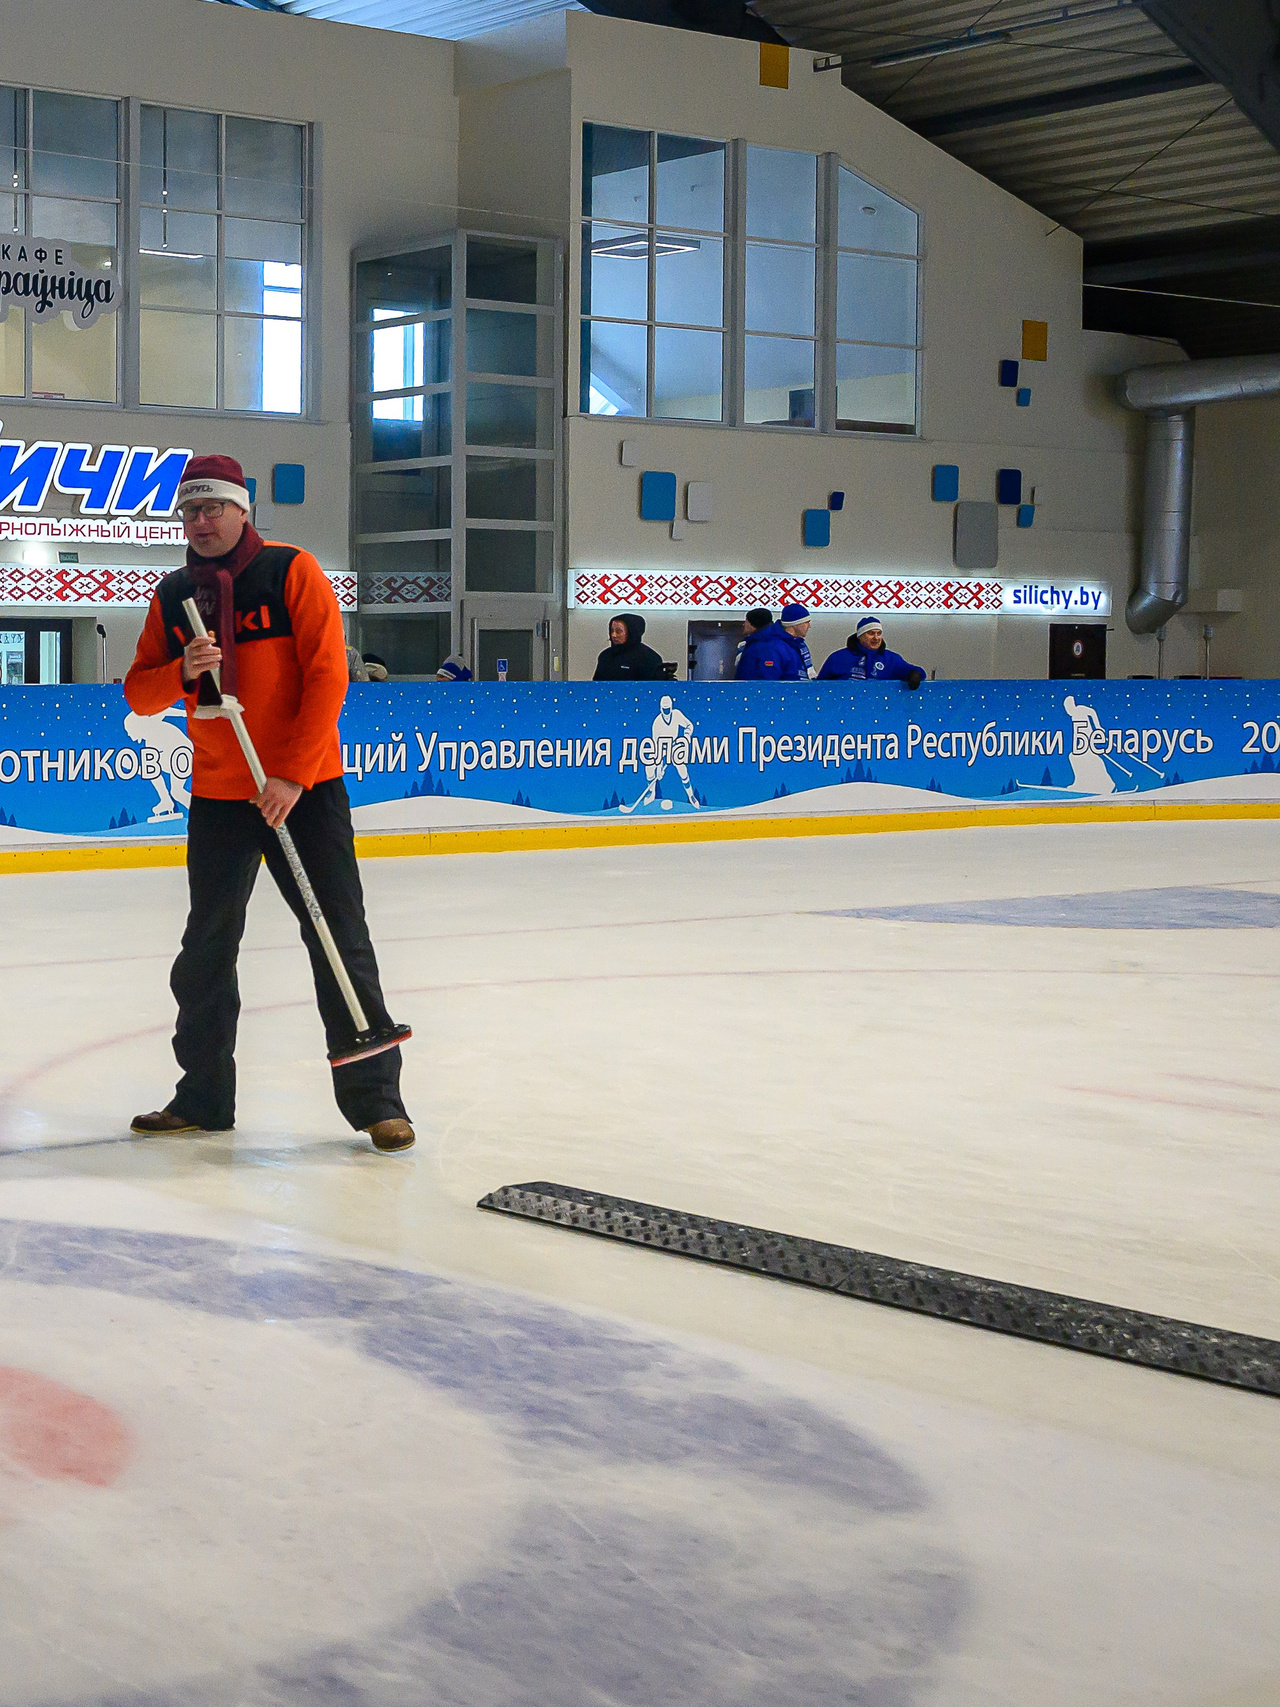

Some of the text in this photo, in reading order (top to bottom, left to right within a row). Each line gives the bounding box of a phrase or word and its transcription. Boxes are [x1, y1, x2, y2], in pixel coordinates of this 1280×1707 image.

[1, 244, 63, 265] КАФЕ
[1012, 585, 1103, 611] silichy.by
[342, 731, 408, 781] ций
[415, 730, 612, 781] Управления
[619, 735, 730, 775] делами
[738, 726, 899, 772] Президента
[907, 720, 1063, 767] Республики
[1072, 720, 1214, 763] Беларусь
[1242, 720, 1280, 754] 20
